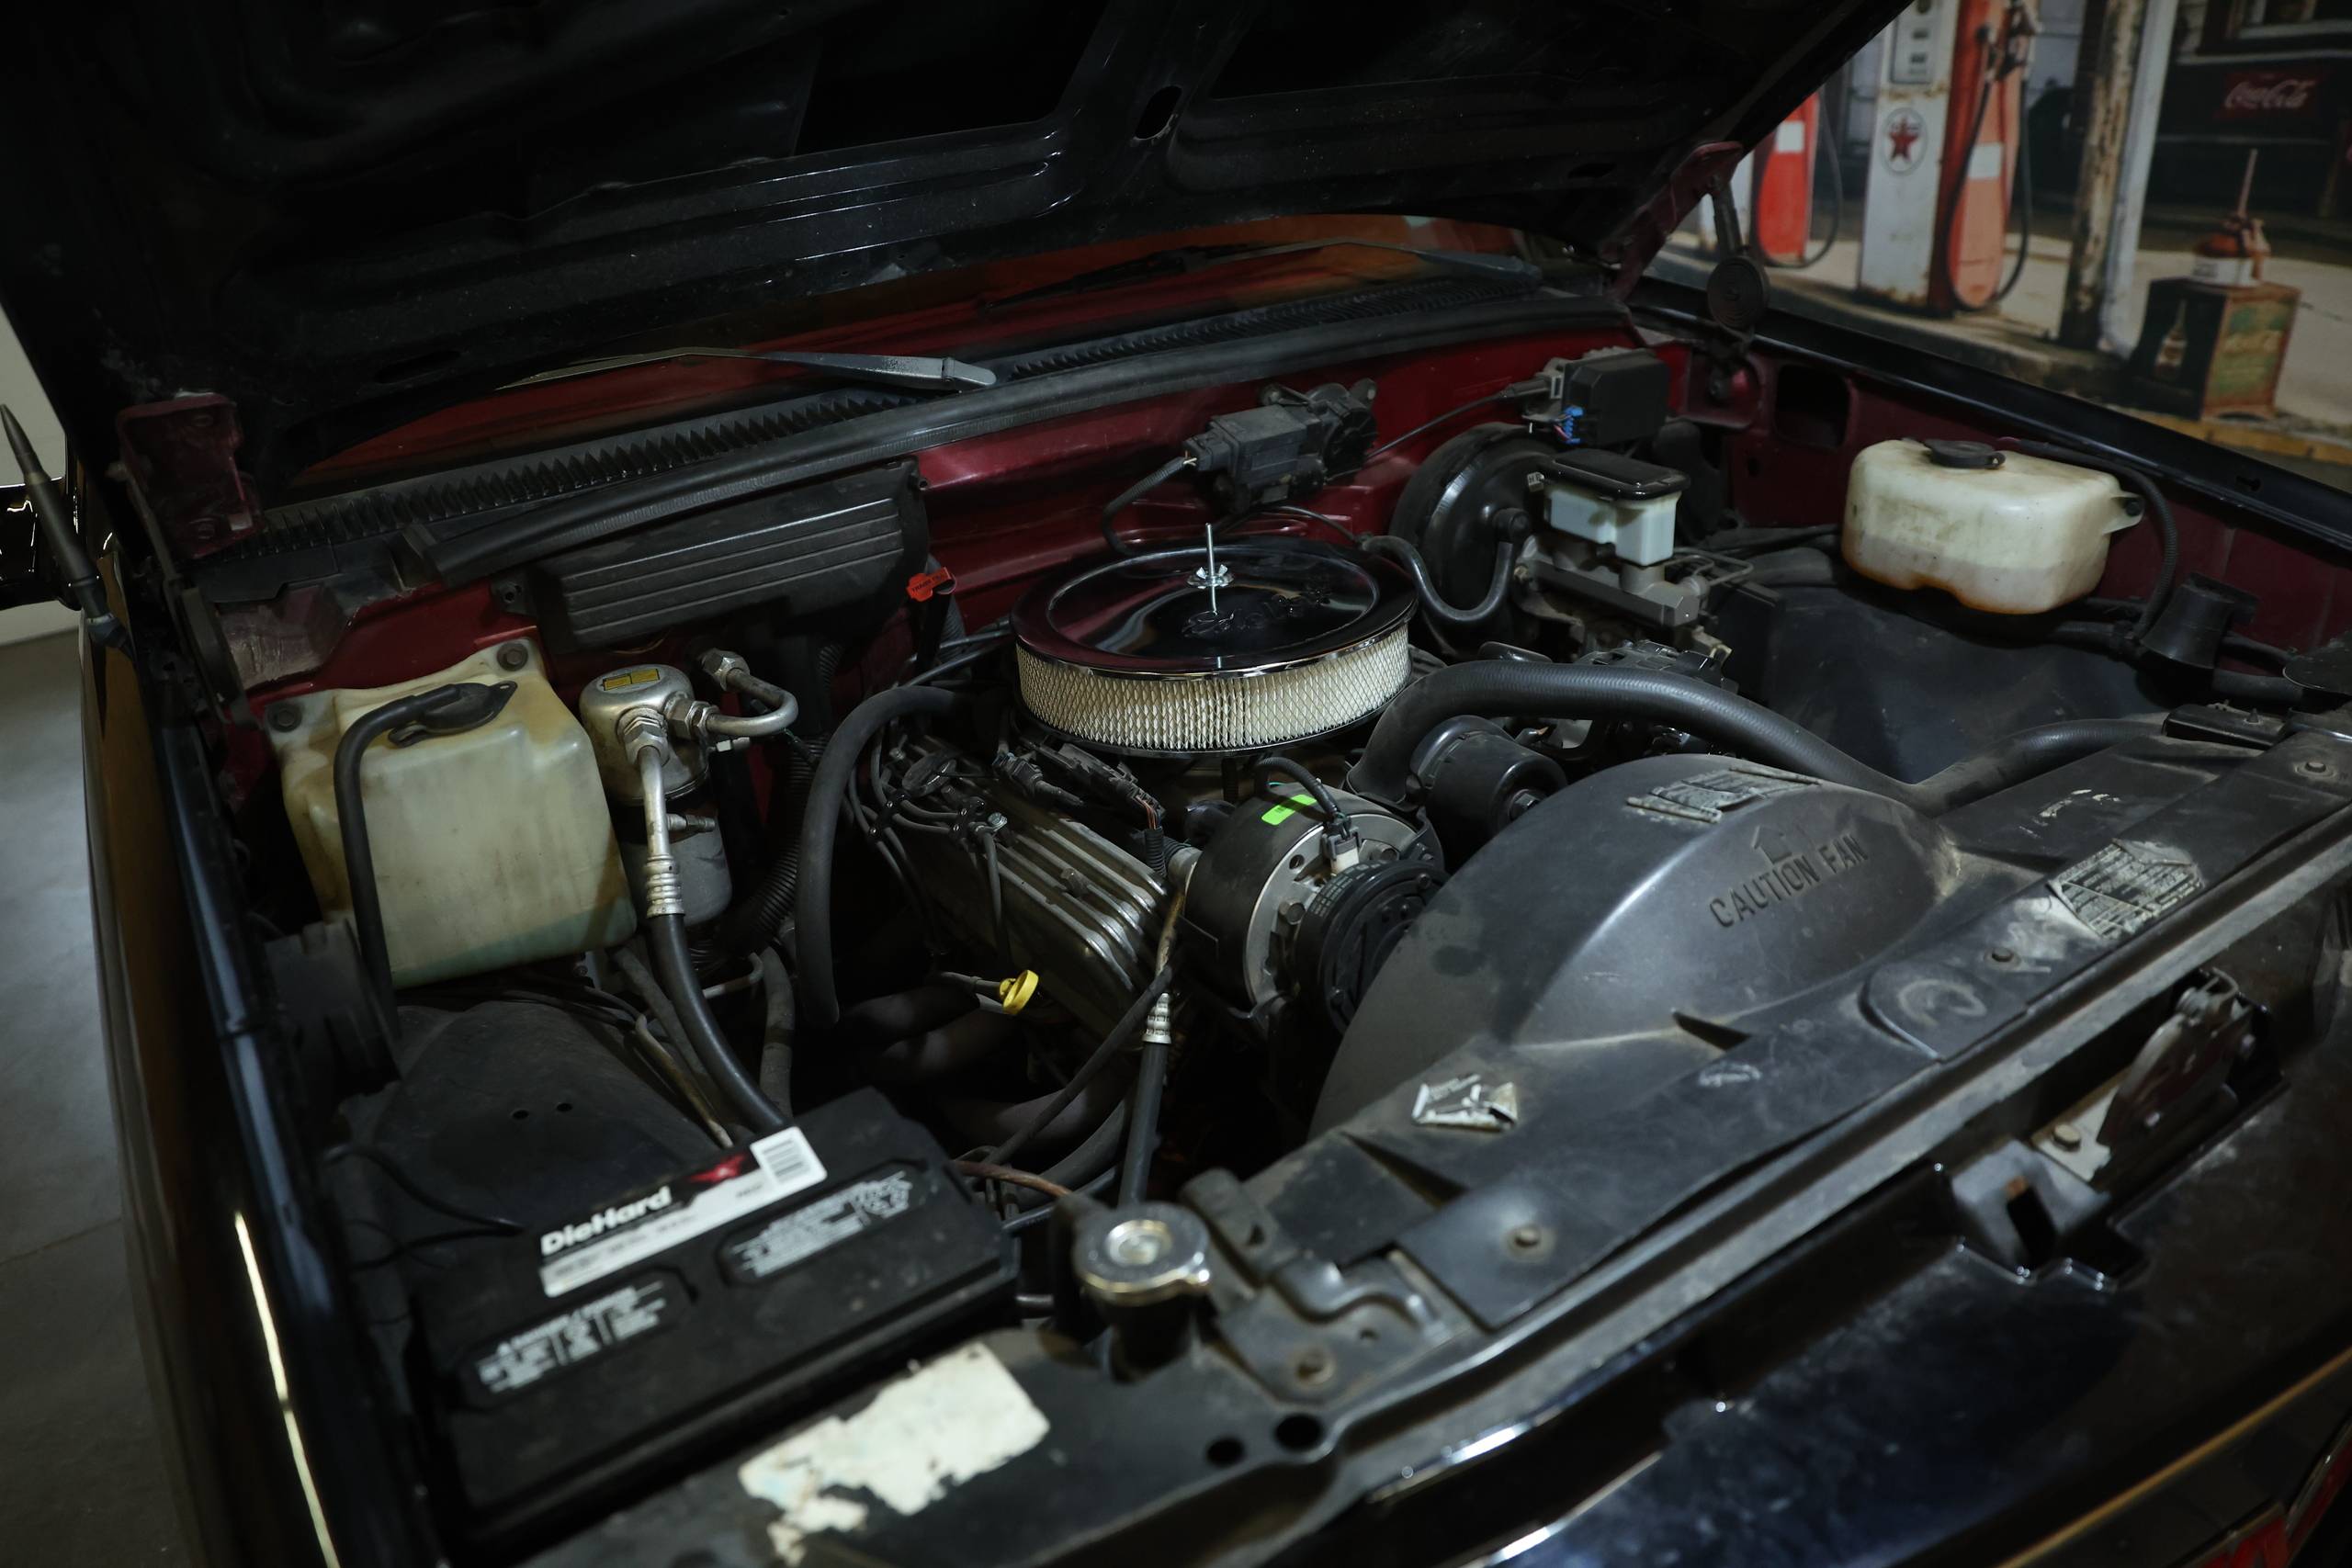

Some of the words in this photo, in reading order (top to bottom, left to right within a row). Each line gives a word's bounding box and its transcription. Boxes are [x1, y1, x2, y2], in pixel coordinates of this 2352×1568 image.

[1710, 854, 1821, 928] CAUTION
[1818, 833, 1869, 874] FAN
[540, 1185, 673, 1256] DieHard
